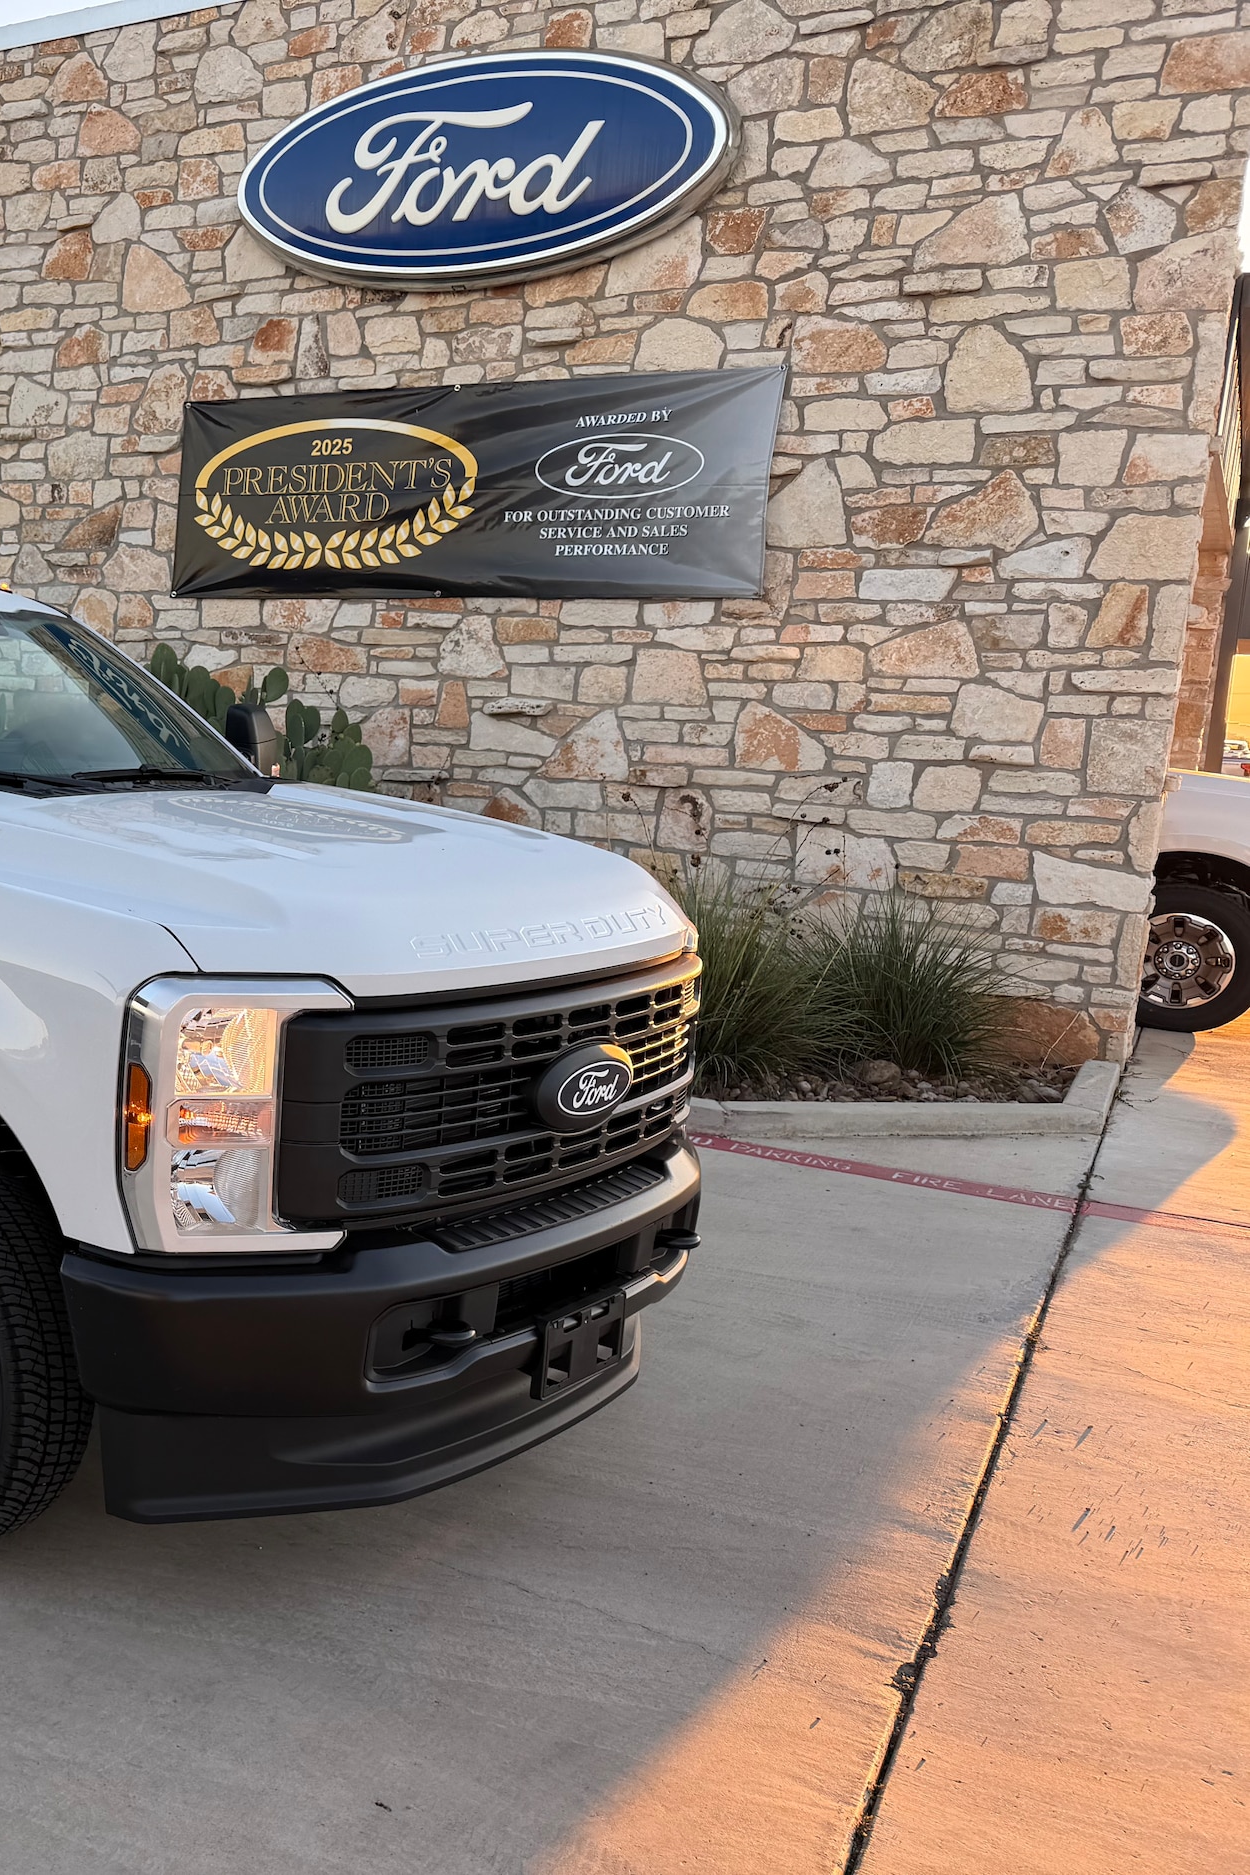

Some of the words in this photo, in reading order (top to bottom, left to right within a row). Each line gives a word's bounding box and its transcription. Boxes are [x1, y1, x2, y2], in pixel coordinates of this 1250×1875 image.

[325, 101, 605, 234] Ford
[576, 411, 647, 428] AWARDED
[651, 408, 672, 422] BY
[310, 438, 353, 456] 2025
[565, 442, 673, 487] Ford
[221, 458, 452, 496] PRESIDENT'S
[264, 492, 390, 525] AWARD
[503, 510, 533, 523] FOR
[536, 507, 642, 522] OUTSTANDING
[646, 504, 730, 519] CUSTOMER
[539, 526, 602, 540] SERVICE
[606, 525, 639, 539] AND
[641, 524, 688, 538] SALES
[554, 543, 669, 557] PERFORMANCE
[409, 921, 584, 959] SUPER
[580, 904, 666, 940] DUTY
[572, 1069, 620, 1108] Ford
[729, 1141, 852, 1172] PARKING
[891, 1171, 964, 1192] FIRE
[986, 1188, 1070, 1209] LANE
